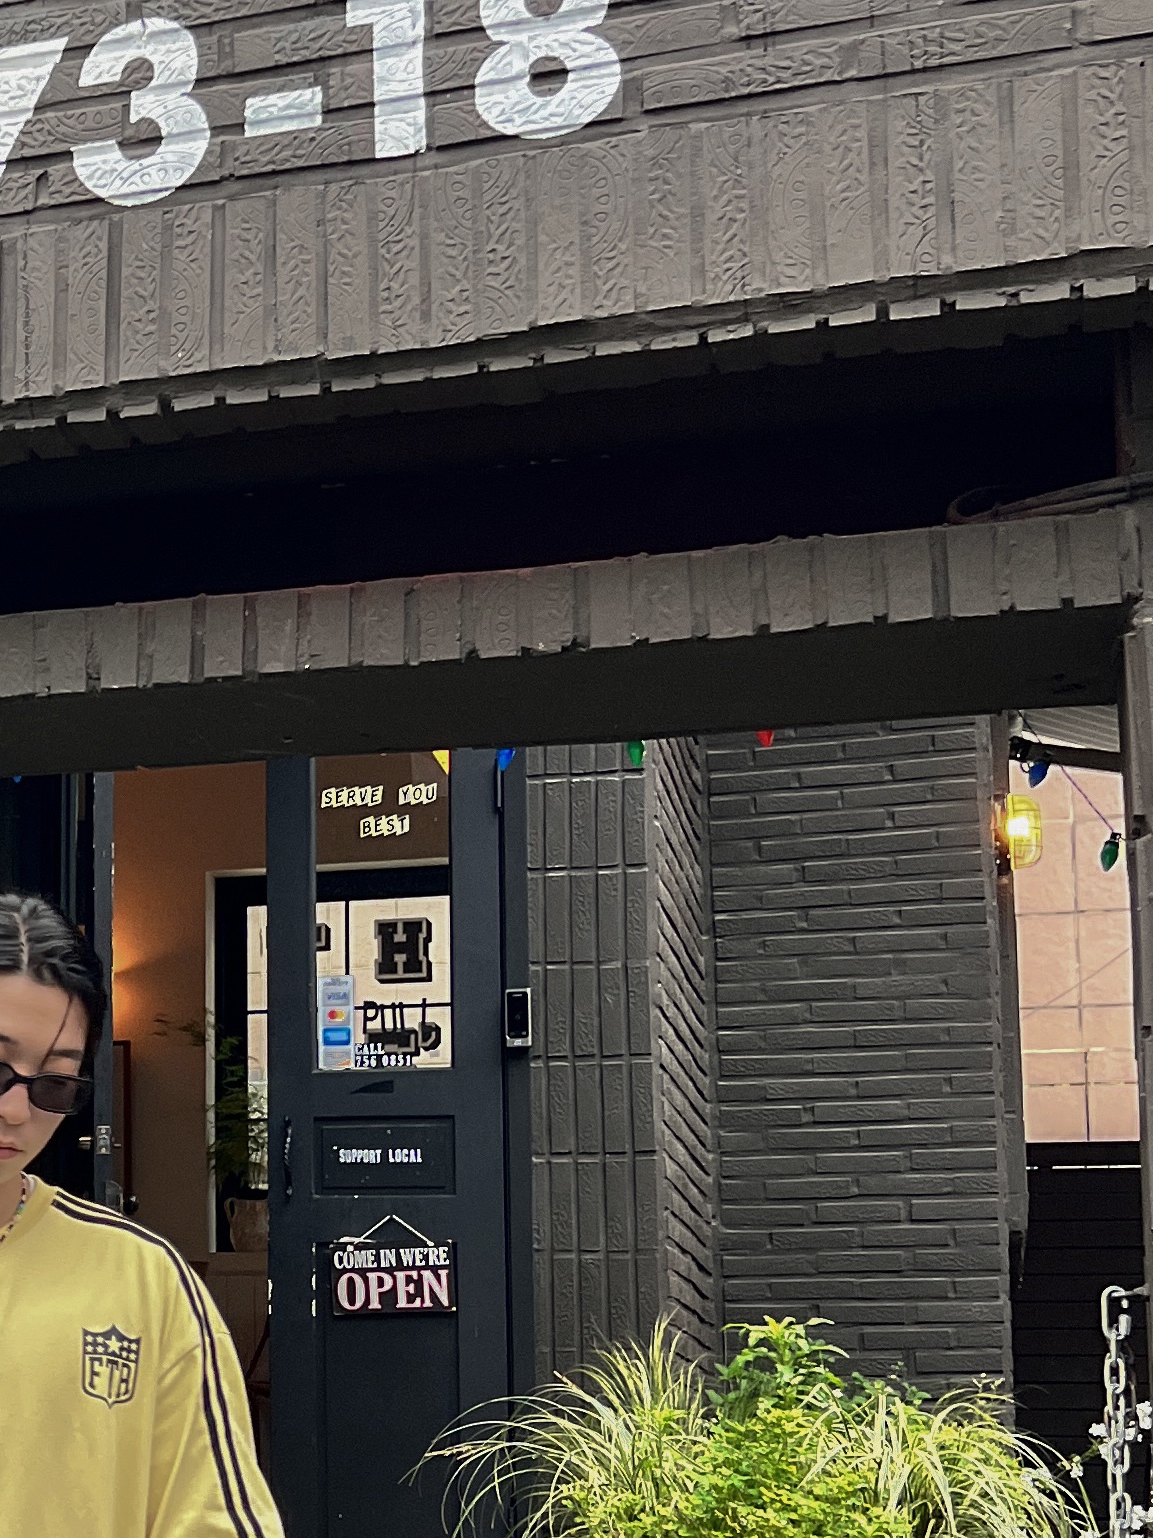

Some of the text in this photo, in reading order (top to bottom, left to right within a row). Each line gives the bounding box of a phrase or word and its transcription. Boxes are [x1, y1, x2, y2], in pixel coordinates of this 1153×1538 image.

[322, 784, 436, 806] SERVE YOU
[361, 816, 408, 836] BEST
[355, 1042, 385, 1055] CALL
[339, 1148, 422, 1164] SUPPORT LOCAL
[334, 1246, 450, 1270] COME IN WE'RE
[337, 1269, 449, 1311] OPEN
